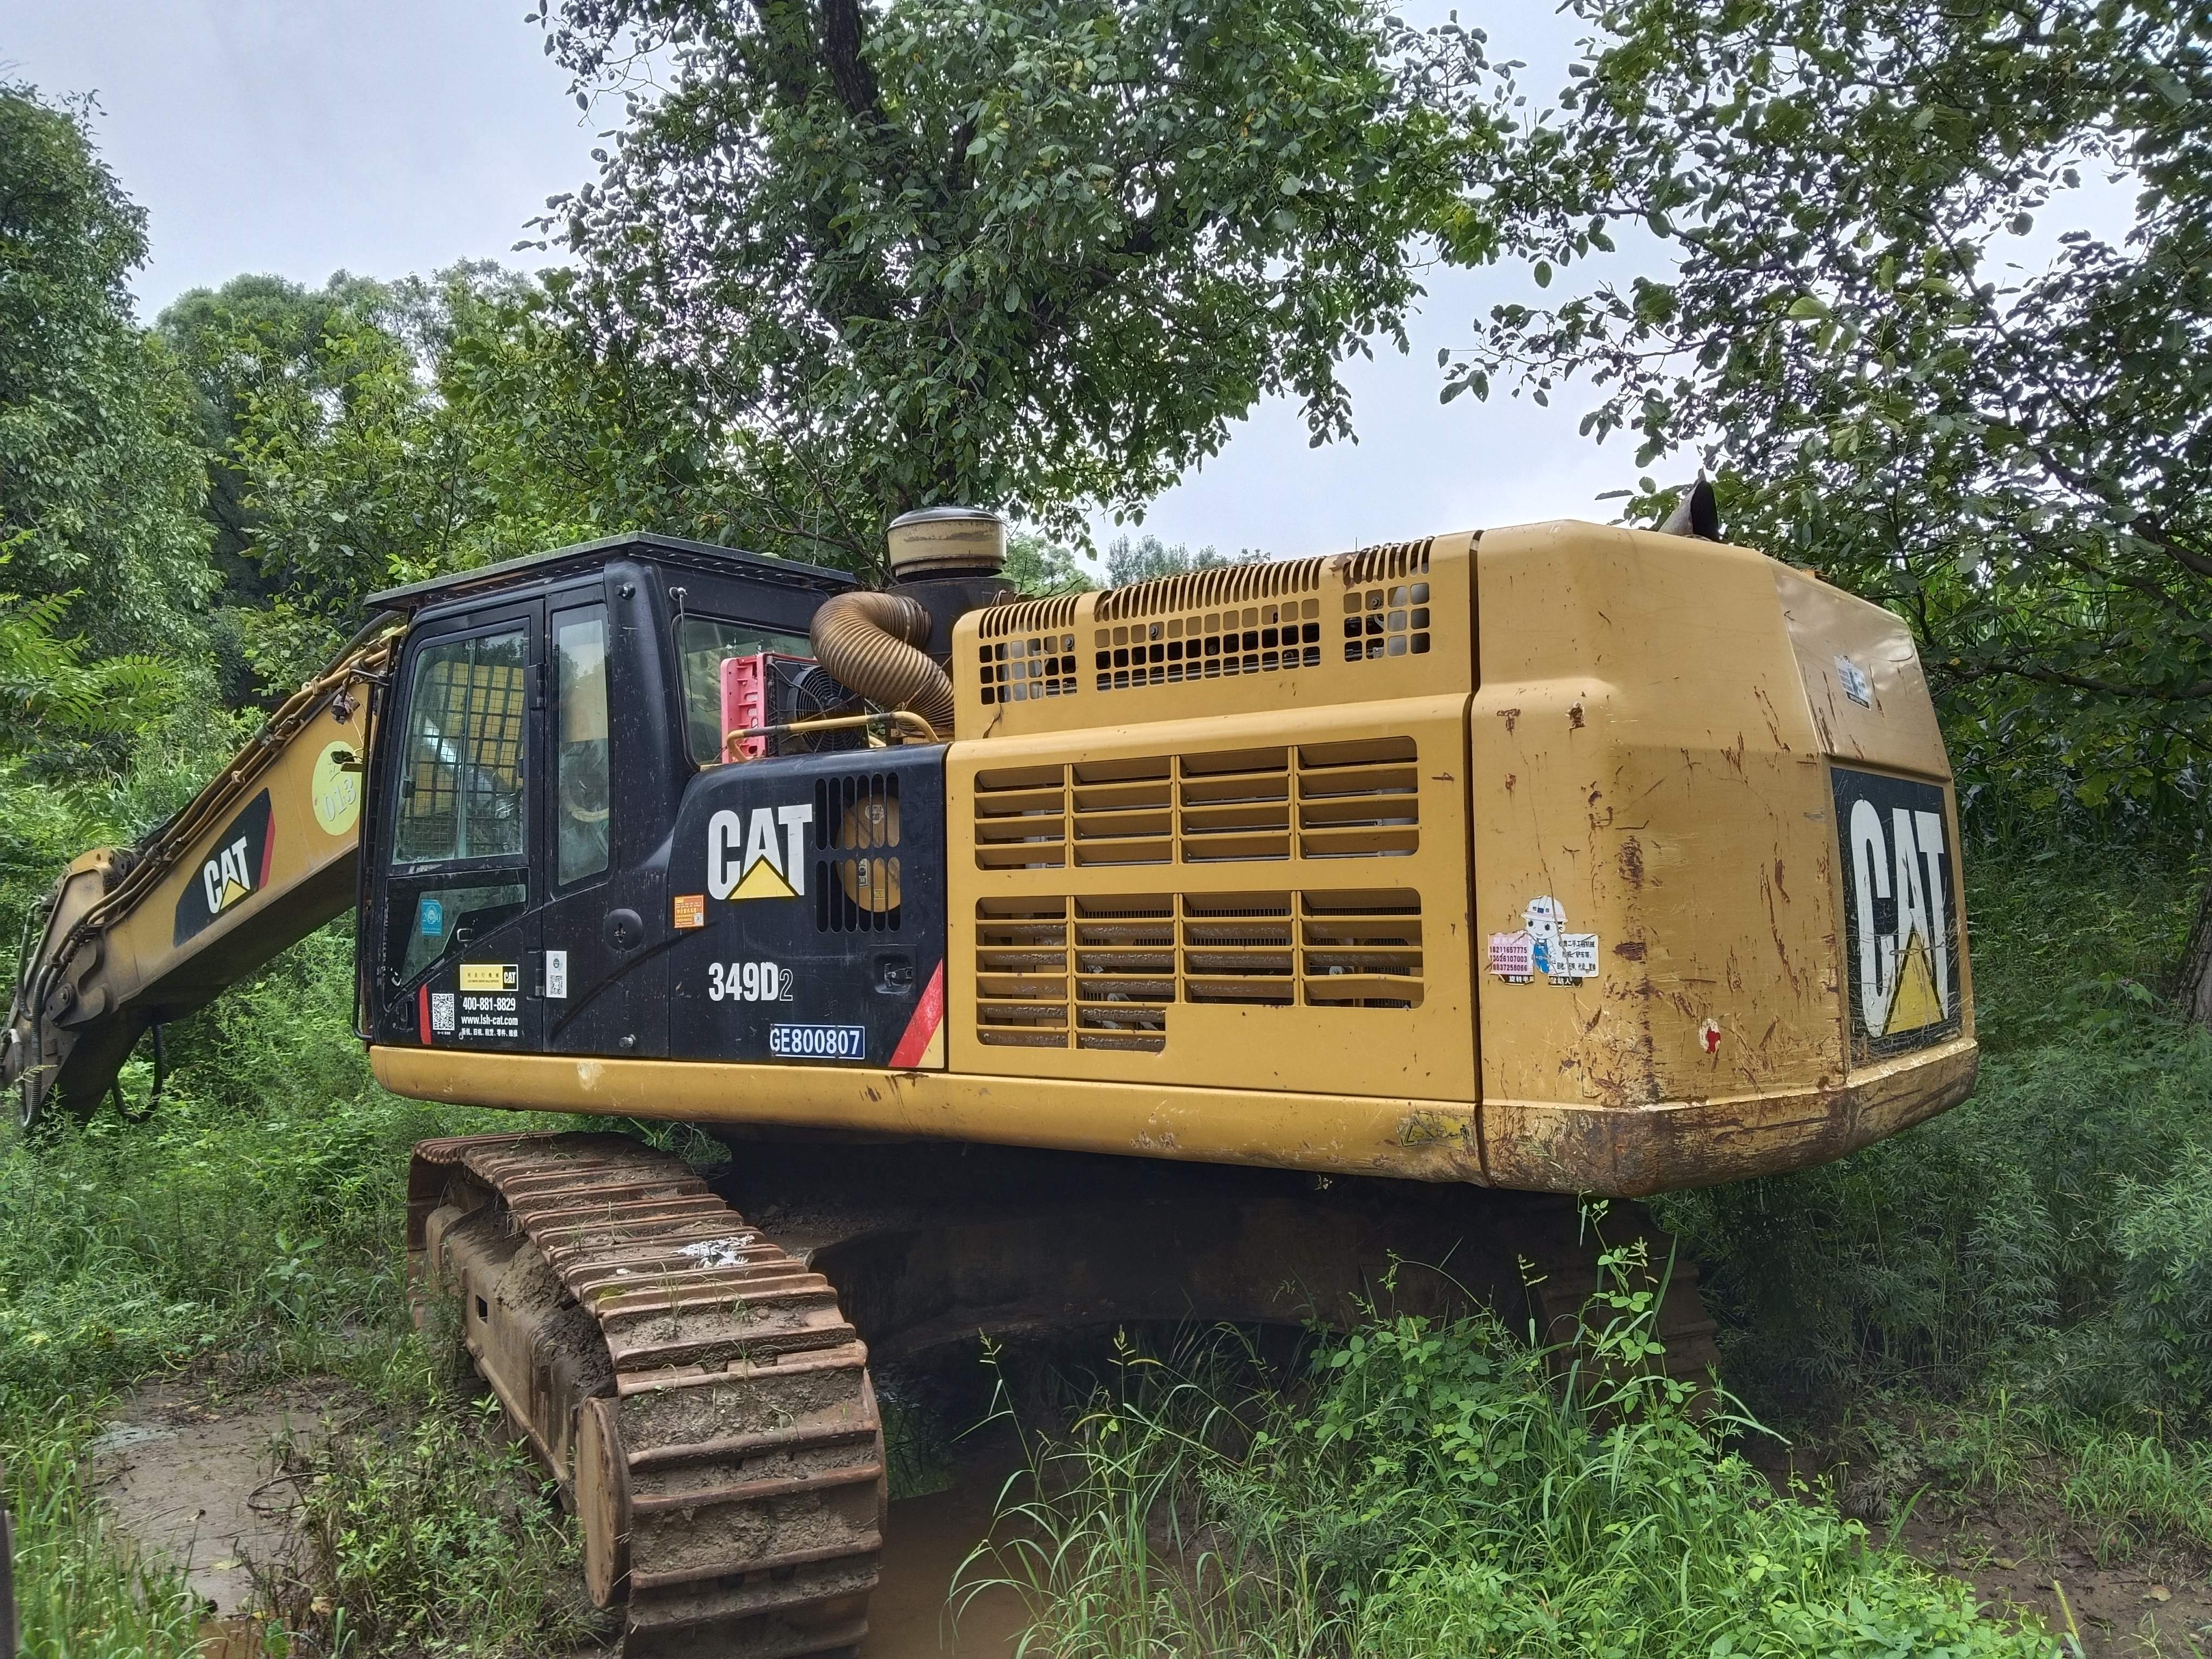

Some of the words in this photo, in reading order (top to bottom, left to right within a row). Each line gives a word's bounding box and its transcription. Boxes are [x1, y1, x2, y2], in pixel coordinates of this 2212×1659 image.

[323, 776, 356, 822] 013
[708, 804, 813, 900] CAT
[203, 836, 251, 914] CAT
[1850, 799, 1949, 1038] CAT
[503, 972, 516, 984] CAT
[709, 962, 793, 1002] 349D2
[461, 1014, 518, 1026] www.lsh-cat.com
[463, 997, 516, 1011] 400-881-8829
[770, 1028, 860, 1055] GE800807
